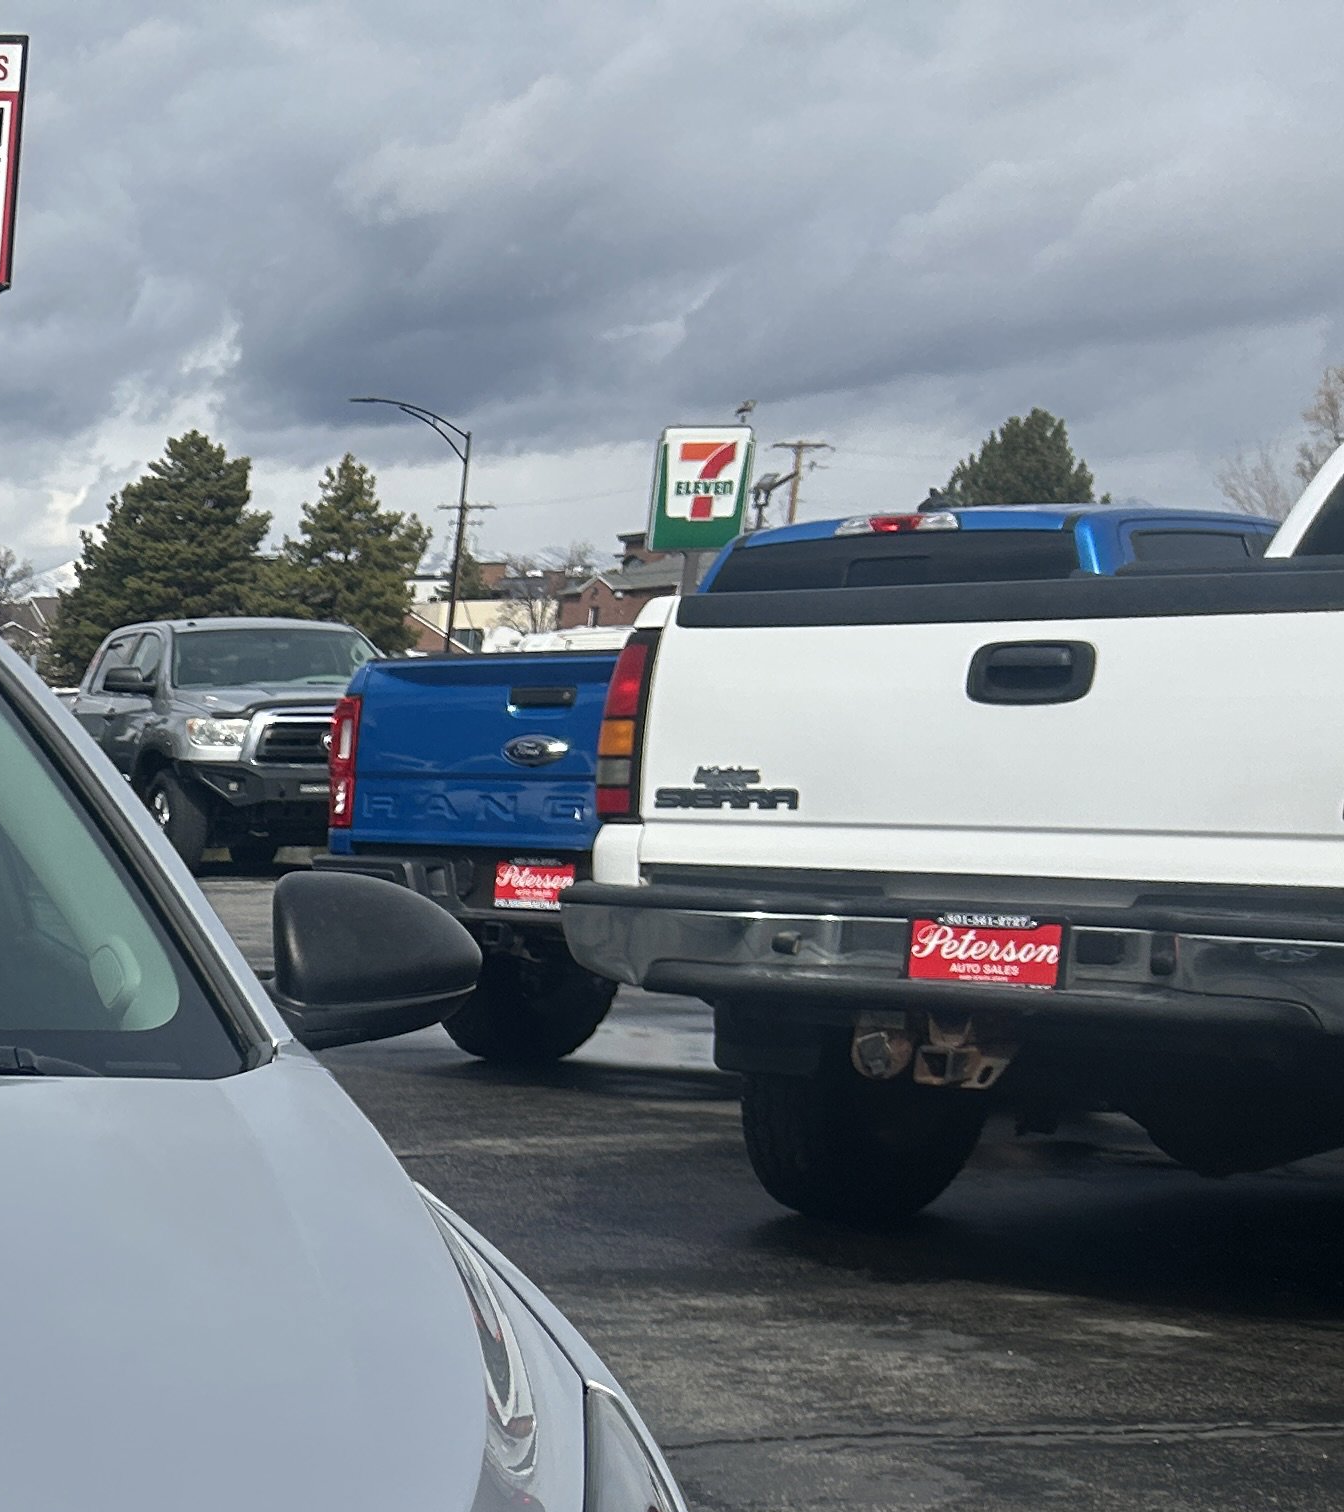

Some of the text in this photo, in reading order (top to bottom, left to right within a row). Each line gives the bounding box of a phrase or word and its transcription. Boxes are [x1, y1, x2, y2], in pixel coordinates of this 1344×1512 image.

[680, 441, 738, 518] 7
[495, 865, 574, 889] Peterson
[912, 924, 1060, 965] Peterson
[949, 963, 1020, 977] AUTO SALES
